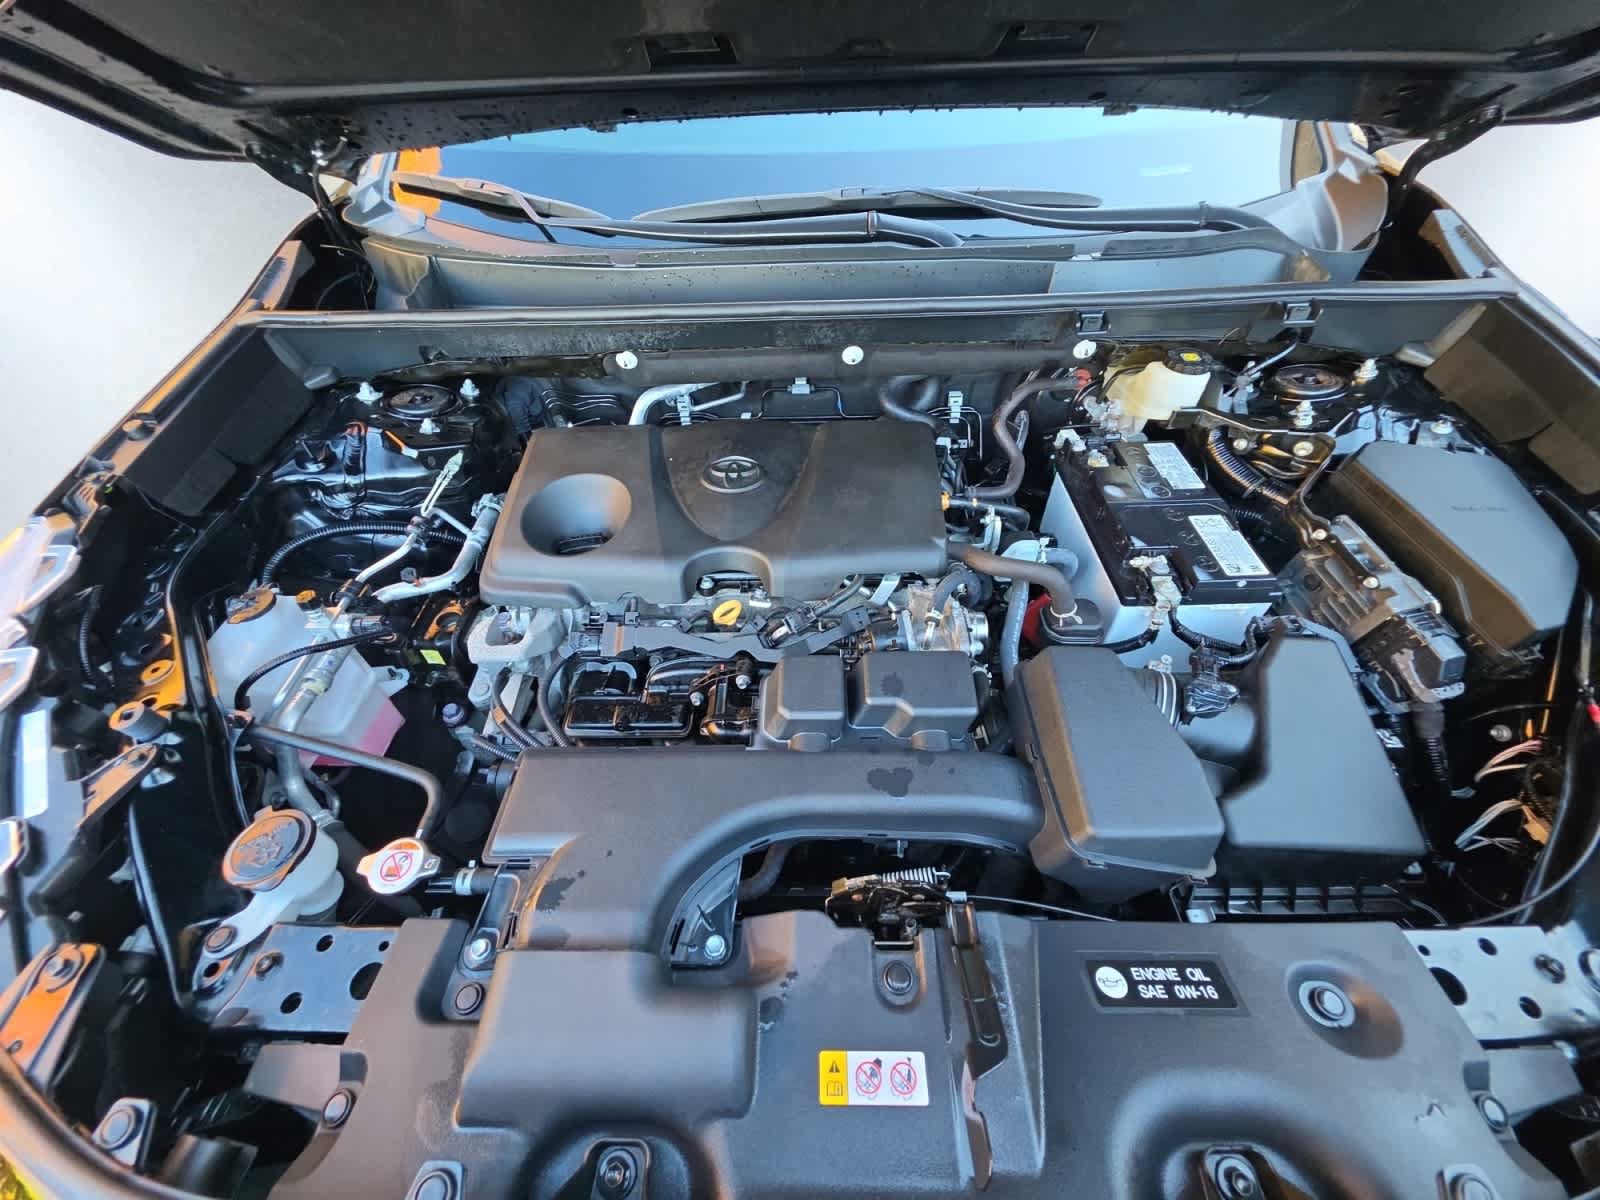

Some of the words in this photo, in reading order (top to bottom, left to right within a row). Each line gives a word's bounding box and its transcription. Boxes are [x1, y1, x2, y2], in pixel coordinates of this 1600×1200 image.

[1130, 967, 1181, 981] ENGINE
[1185, 967, 1211, 982] OIL
[1138, 984, 1168, 999] SAE
[1174, 984, 1219, 999] 0W-16
